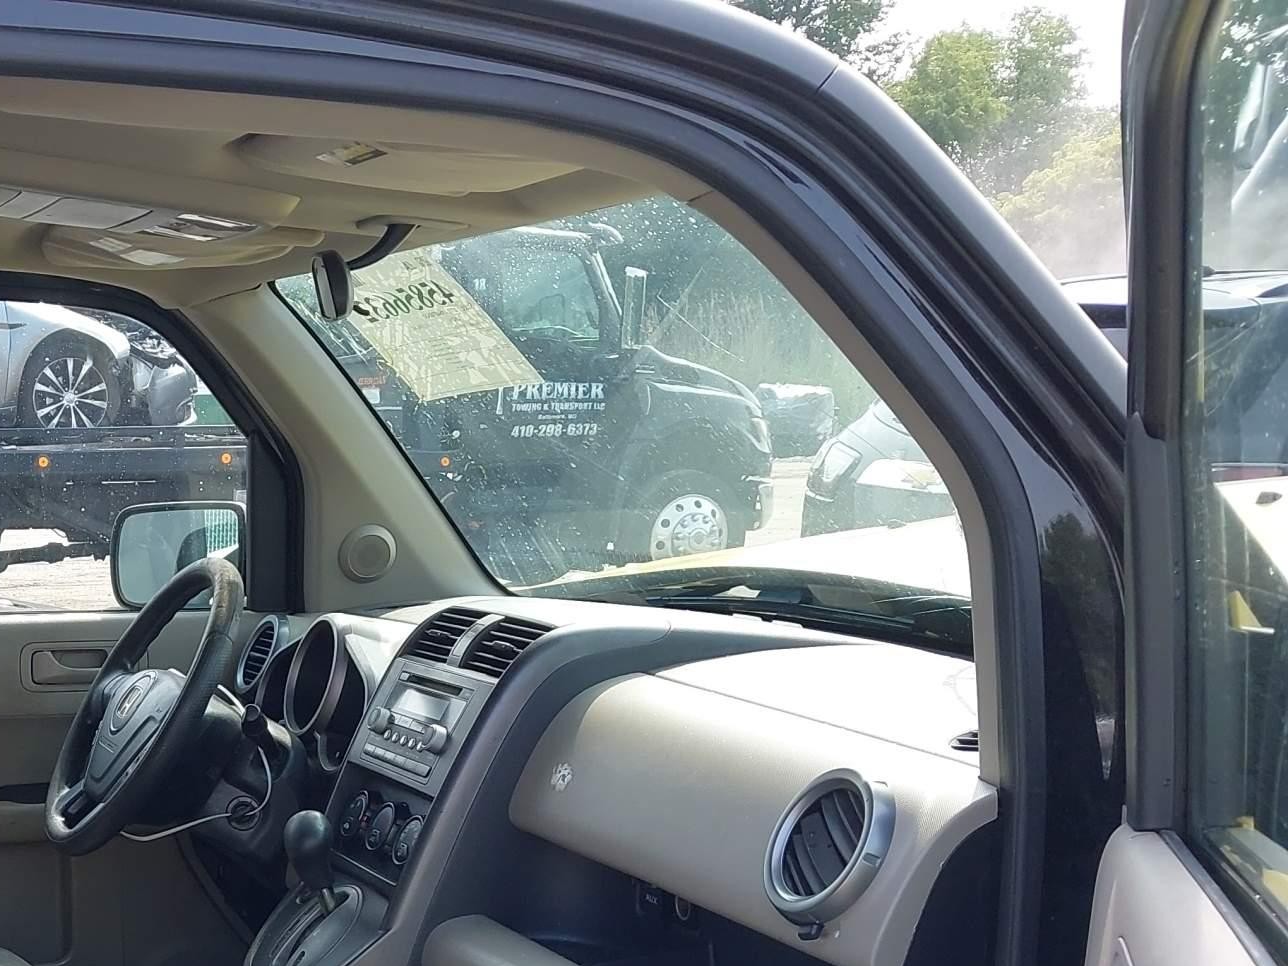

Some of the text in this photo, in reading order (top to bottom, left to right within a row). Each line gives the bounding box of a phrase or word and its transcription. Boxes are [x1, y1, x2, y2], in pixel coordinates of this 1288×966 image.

[511, 381, 605, 400] PREMIER
[512, 403, 542, 412] TOWING
[551, 402, 592, 411] TRANSPORT
[511, 423, 598, 438] 410-298-6373
